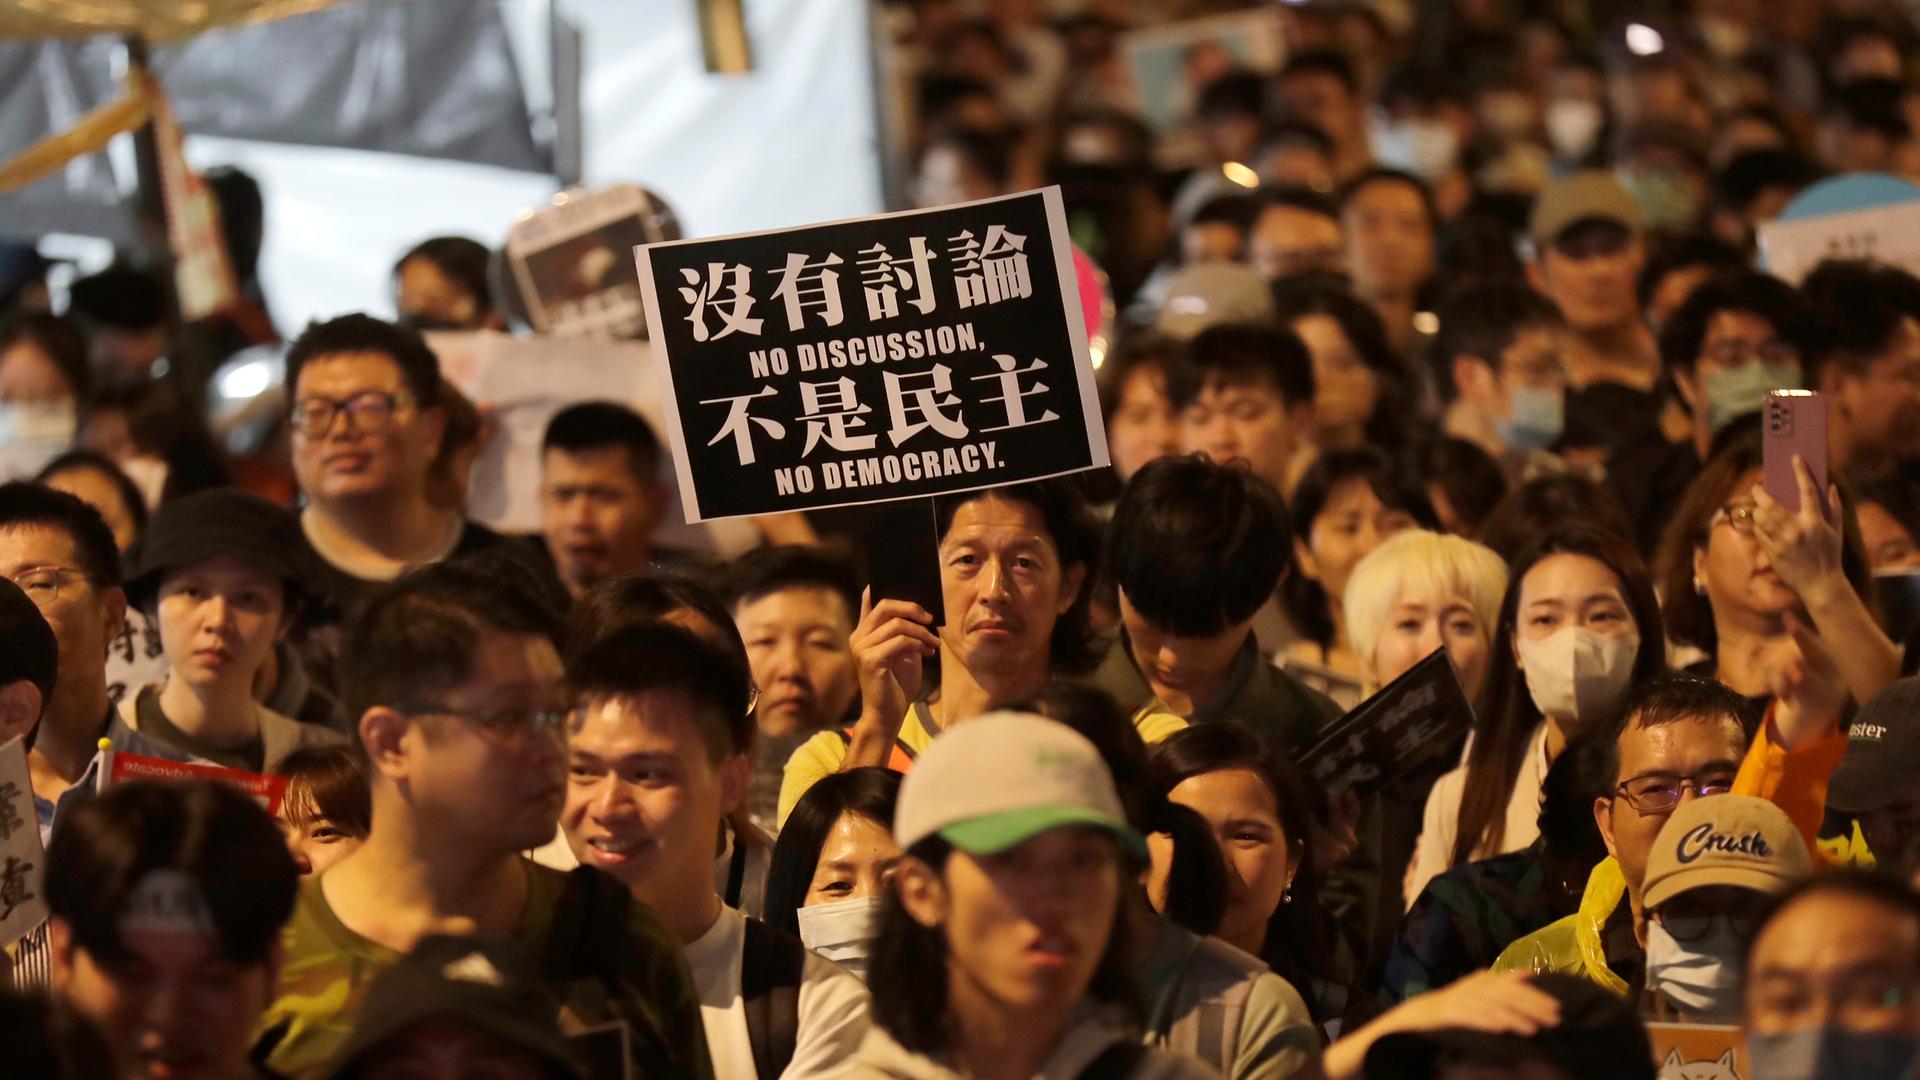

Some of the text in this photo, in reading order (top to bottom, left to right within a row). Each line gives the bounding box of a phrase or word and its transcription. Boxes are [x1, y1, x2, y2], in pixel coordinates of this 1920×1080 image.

[677, 224, 1034, 343] 沒有討論
[749, 323, 986, 379] NO DISCUSSION,
[700, 354, 1061, 467] 不是民主
[774, 441, 1006, 496] NO DEMOCRACY.
[1676, 822, 1774, 865] Crush
